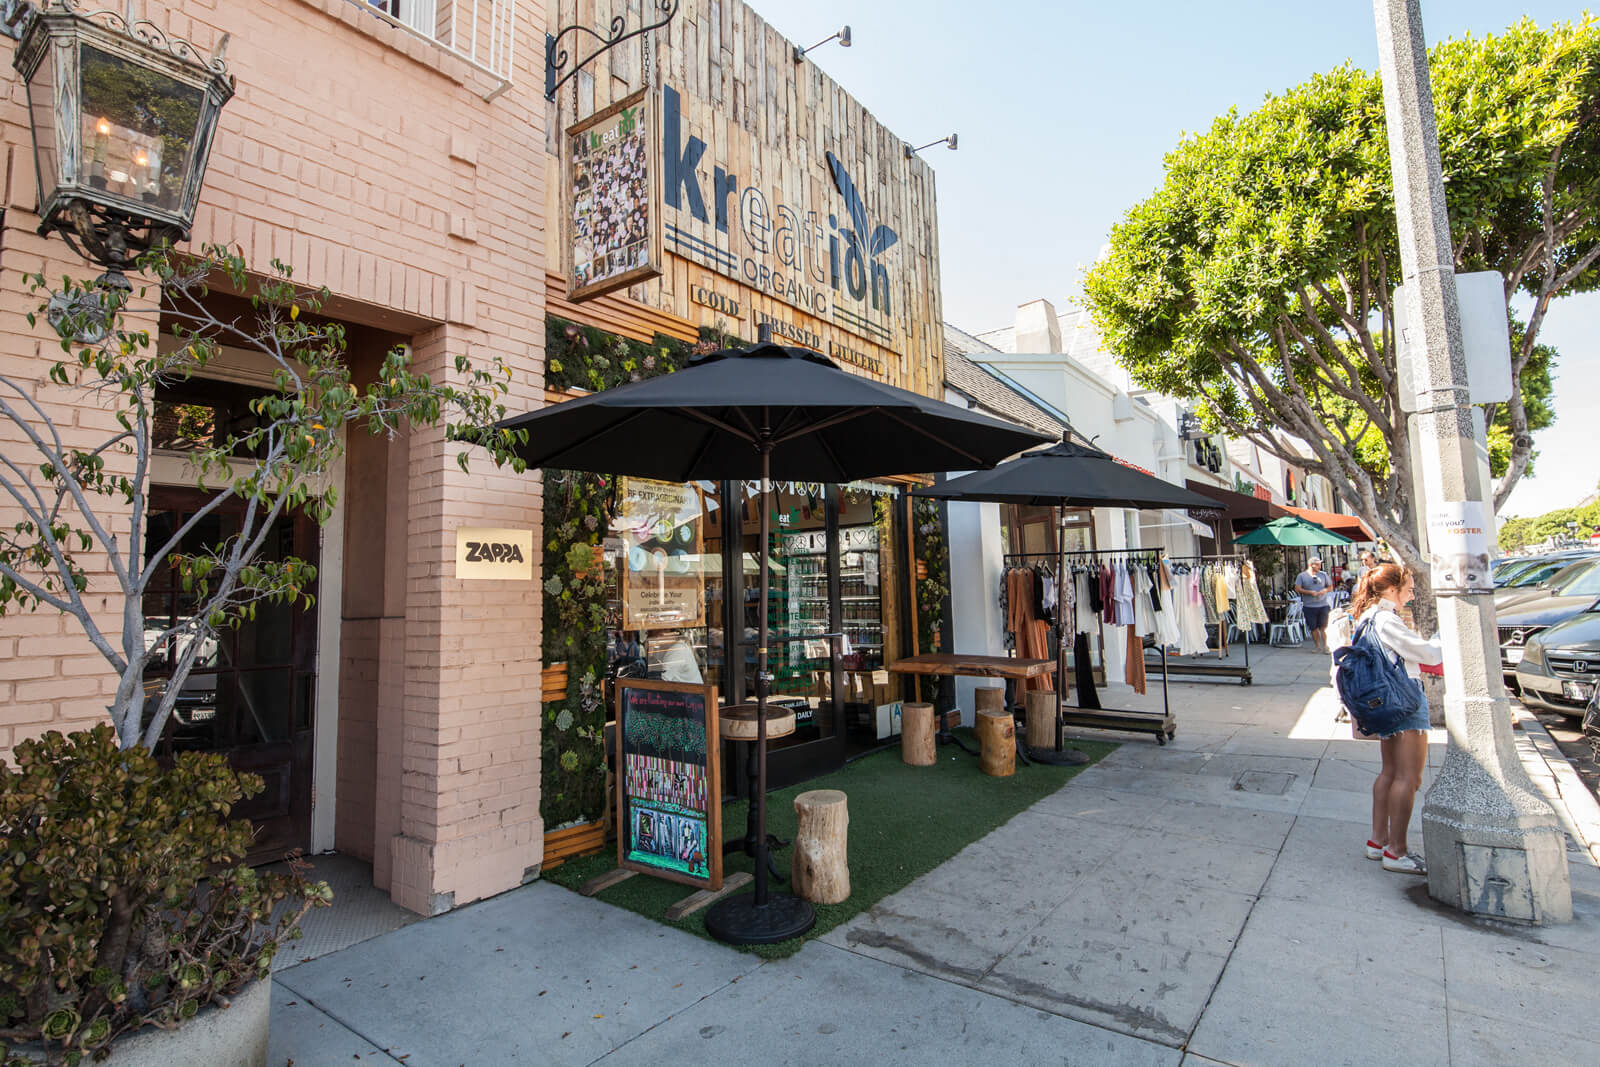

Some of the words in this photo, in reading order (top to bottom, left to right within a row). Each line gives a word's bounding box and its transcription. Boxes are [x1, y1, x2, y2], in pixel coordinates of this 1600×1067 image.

[591, 107, 637, 149] kreation
[664, 84, 893, 317] kreation
[697, 287, 739, 316] COLD
[743, 257, 827, 314] ORGANIC
[760, 311, 820, 349] PRESSED
[836, 343, 882, 373] JUICERY
[465, 542, 524, 563] ZAPPA
[797, 710, 813, 720] DAILY
